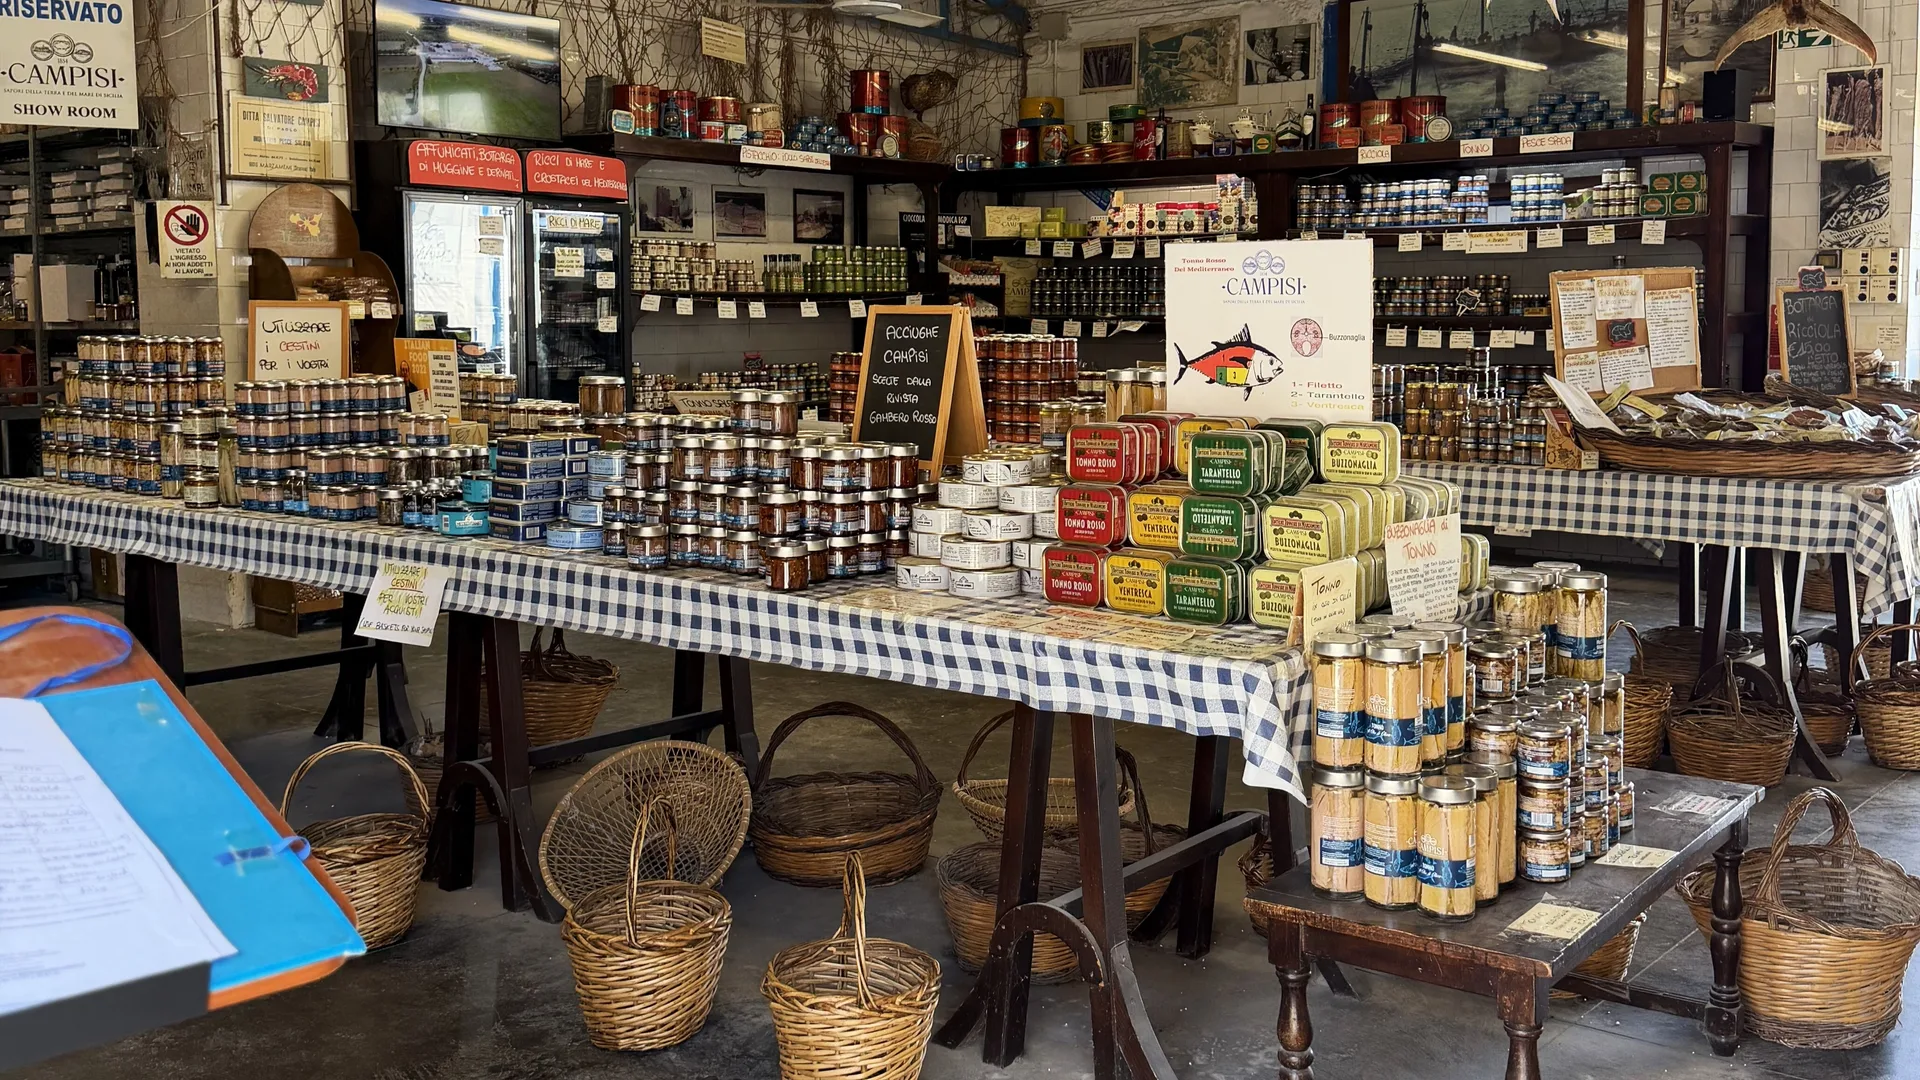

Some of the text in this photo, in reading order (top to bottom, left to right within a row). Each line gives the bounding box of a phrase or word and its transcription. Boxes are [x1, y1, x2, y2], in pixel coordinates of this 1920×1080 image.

[0, 0, 123, 24] RISERVATO
[8, 63, 117, 89] CAMPISI
[13, 103, 117, 119] SHOW ROOM
[242, 110, 260, 121] DITTA
[262, 112, 295, 125] SALVATORE
[1522, 136, 1572, 148] PESCE SPADA
[1460, 143, 1490, 154] TONNO
[478, 166, 484, 176] E
[600, 160, 605, 170] E
[579, 217, 600, 229] MARE
[958, 216, 968, 224] IGP
[1226, 277, 1302, 296] CAMPISI
[1785, 296, 1838, 314] BOTTARGA
[1328, 334, 1366, 343] Buzzonaglia
[404, 340, 431, 350] ITALIAN
[409, 352, 428, 362] FOOD
[259, 359, 278, 371] PER
[412, 364, 427, 374] 2022
[872, 373, 932, 386] SCELTE DALLA
[1219, 372, 1223, 380] 2
[1233, 371, 1236, 380] 3
[1307, 391, 1365, 400] Tarantello
[679, 397, 712, 408] TONNO
[1307, 401, 1364, 410] Ventresca
[870, 410, 910, 424] GAMBERO
[1076, 458, 1116, 468] TONNO ROSSO
[1332, 459, 1377, 470] BUZZONAGLIA
[1201, 468, 1240, 478] TARANTELLO
[1064, 518, 1106, 530] TONNO ROSSO
[1193, 514, 1232, 525] TARANTELLO
[1143, 524, 1178, 534] VENTRESCA
[1386, 519, 1436, 539] BUZZONAGLIA
[1275, 537, 1320, 551] BUZZONAGLIA
[1403, 541, 1437, 560] TONNO
[391, 578, 418, 590] CESTINI
[1052, 579, 1092, 592] TONNO ROSSO
[1312, 576, 1341, 595] TONNO
[378, 592, 393, 604] PER
[1119, 586, 1152, 598] VENTRESCA
[1176, 595, 1215, 608] TARANTELLO
[1261, 601, 1294, 613] BUZZONA
